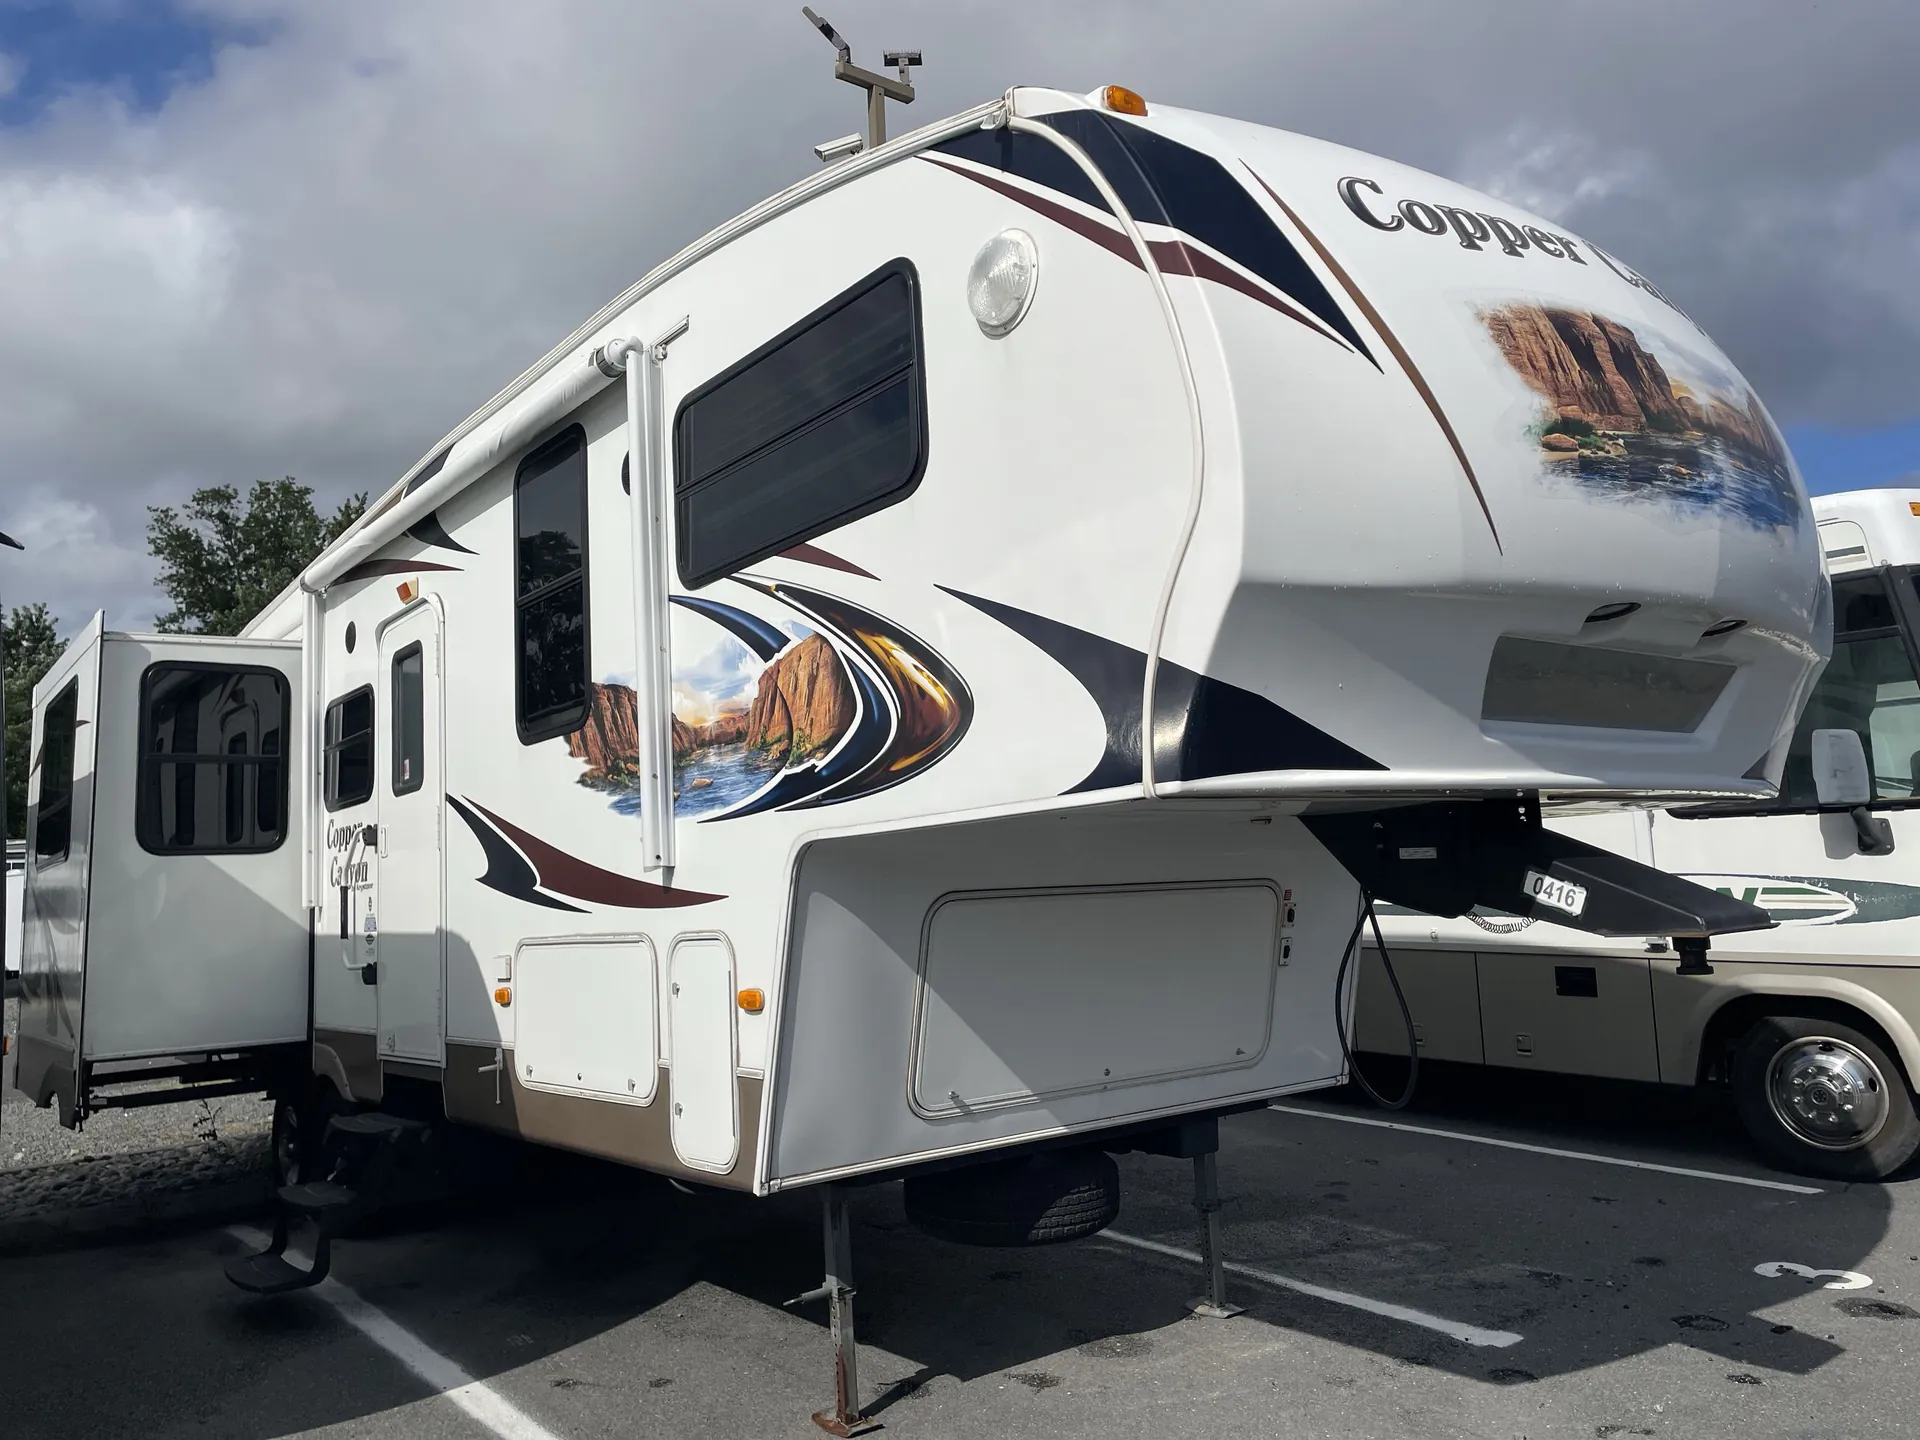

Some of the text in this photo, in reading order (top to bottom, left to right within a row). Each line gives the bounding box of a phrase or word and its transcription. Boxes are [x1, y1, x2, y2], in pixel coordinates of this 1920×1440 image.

[1337, 176, 1588, 266] Copper
[330, 856, 368, 888] Cayon
[1533, 877, 1576, 907] 0416
[1754, 1261, 1873, 1290] 3
